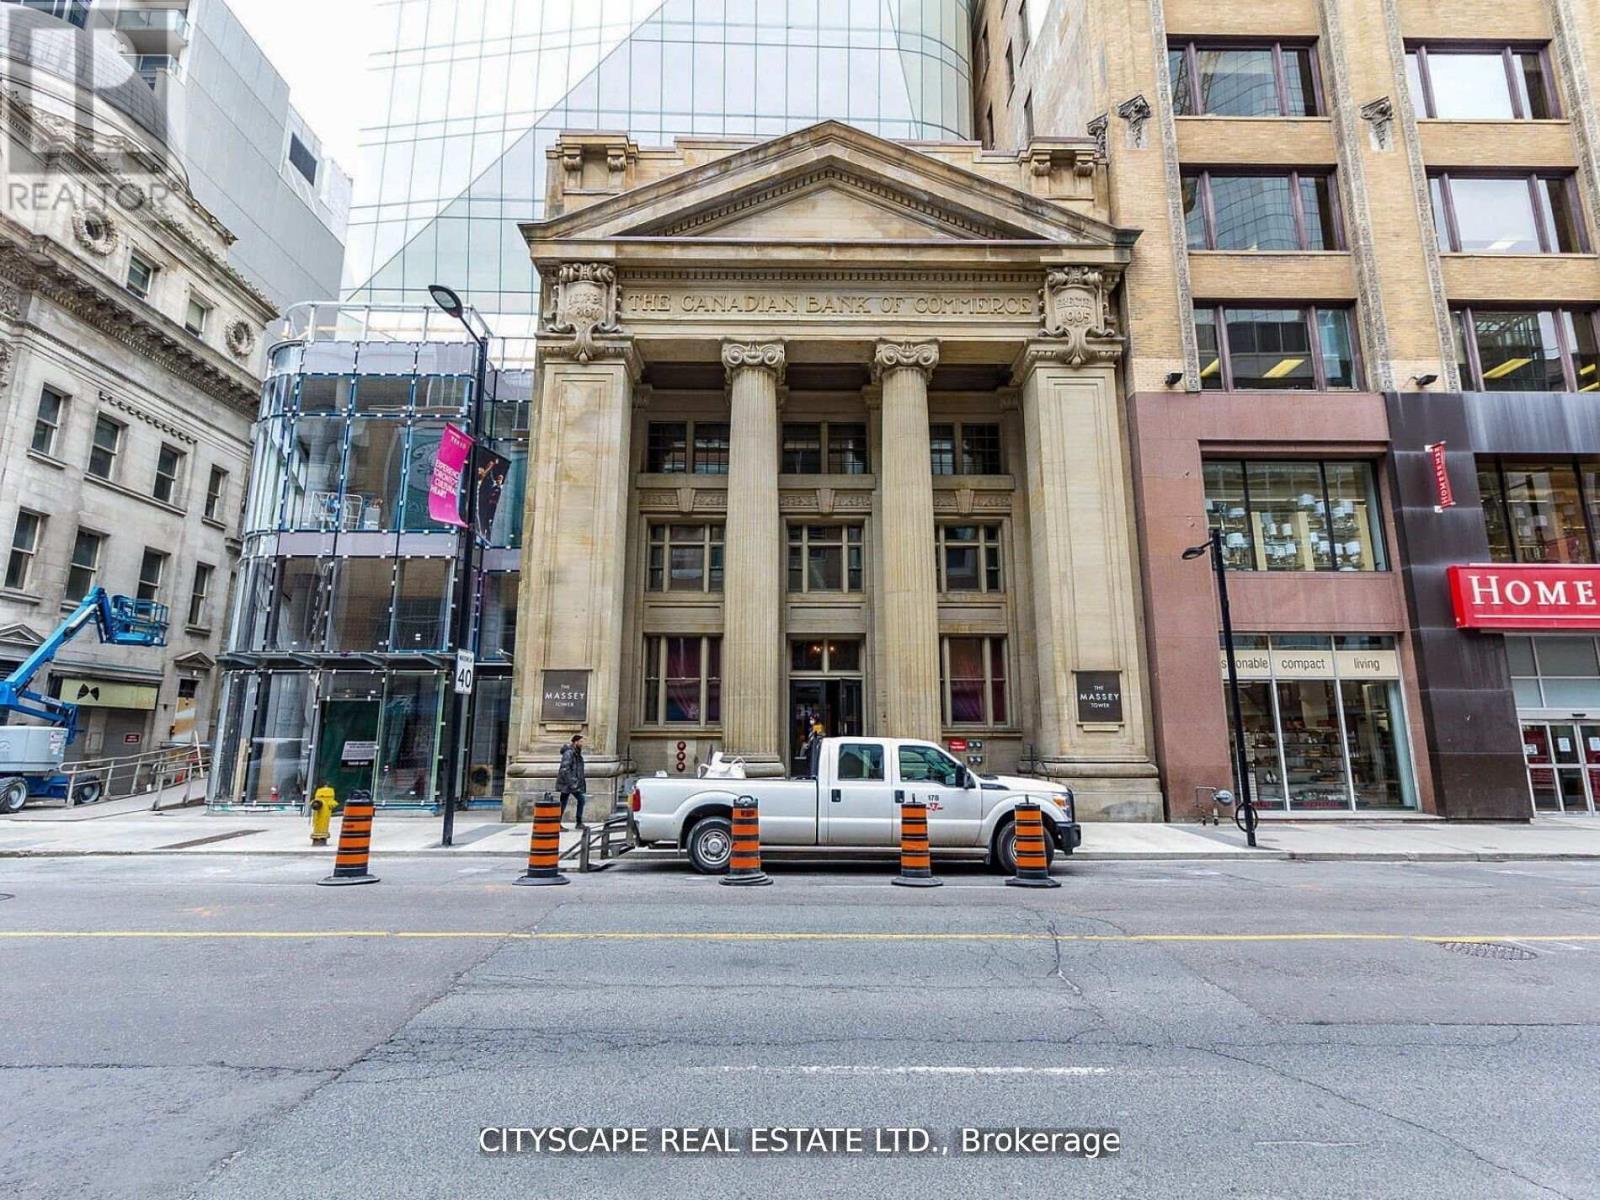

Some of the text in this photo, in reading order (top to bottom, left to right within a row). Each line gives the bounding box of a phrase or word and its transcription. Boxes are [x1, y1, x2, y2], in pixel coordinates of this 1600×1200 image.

[628, 295, 1033, 315] THE CANADIAN BANK OF COMMERCE
[1467, 575, 1598, 606] HOME
[1220, 657, 1381, 671] sonable compact living
[457, 668, 472, 688] 40
[544, 692, 585, 700] MASSEY
[1080, 693, 1120, 701] MASSEY
